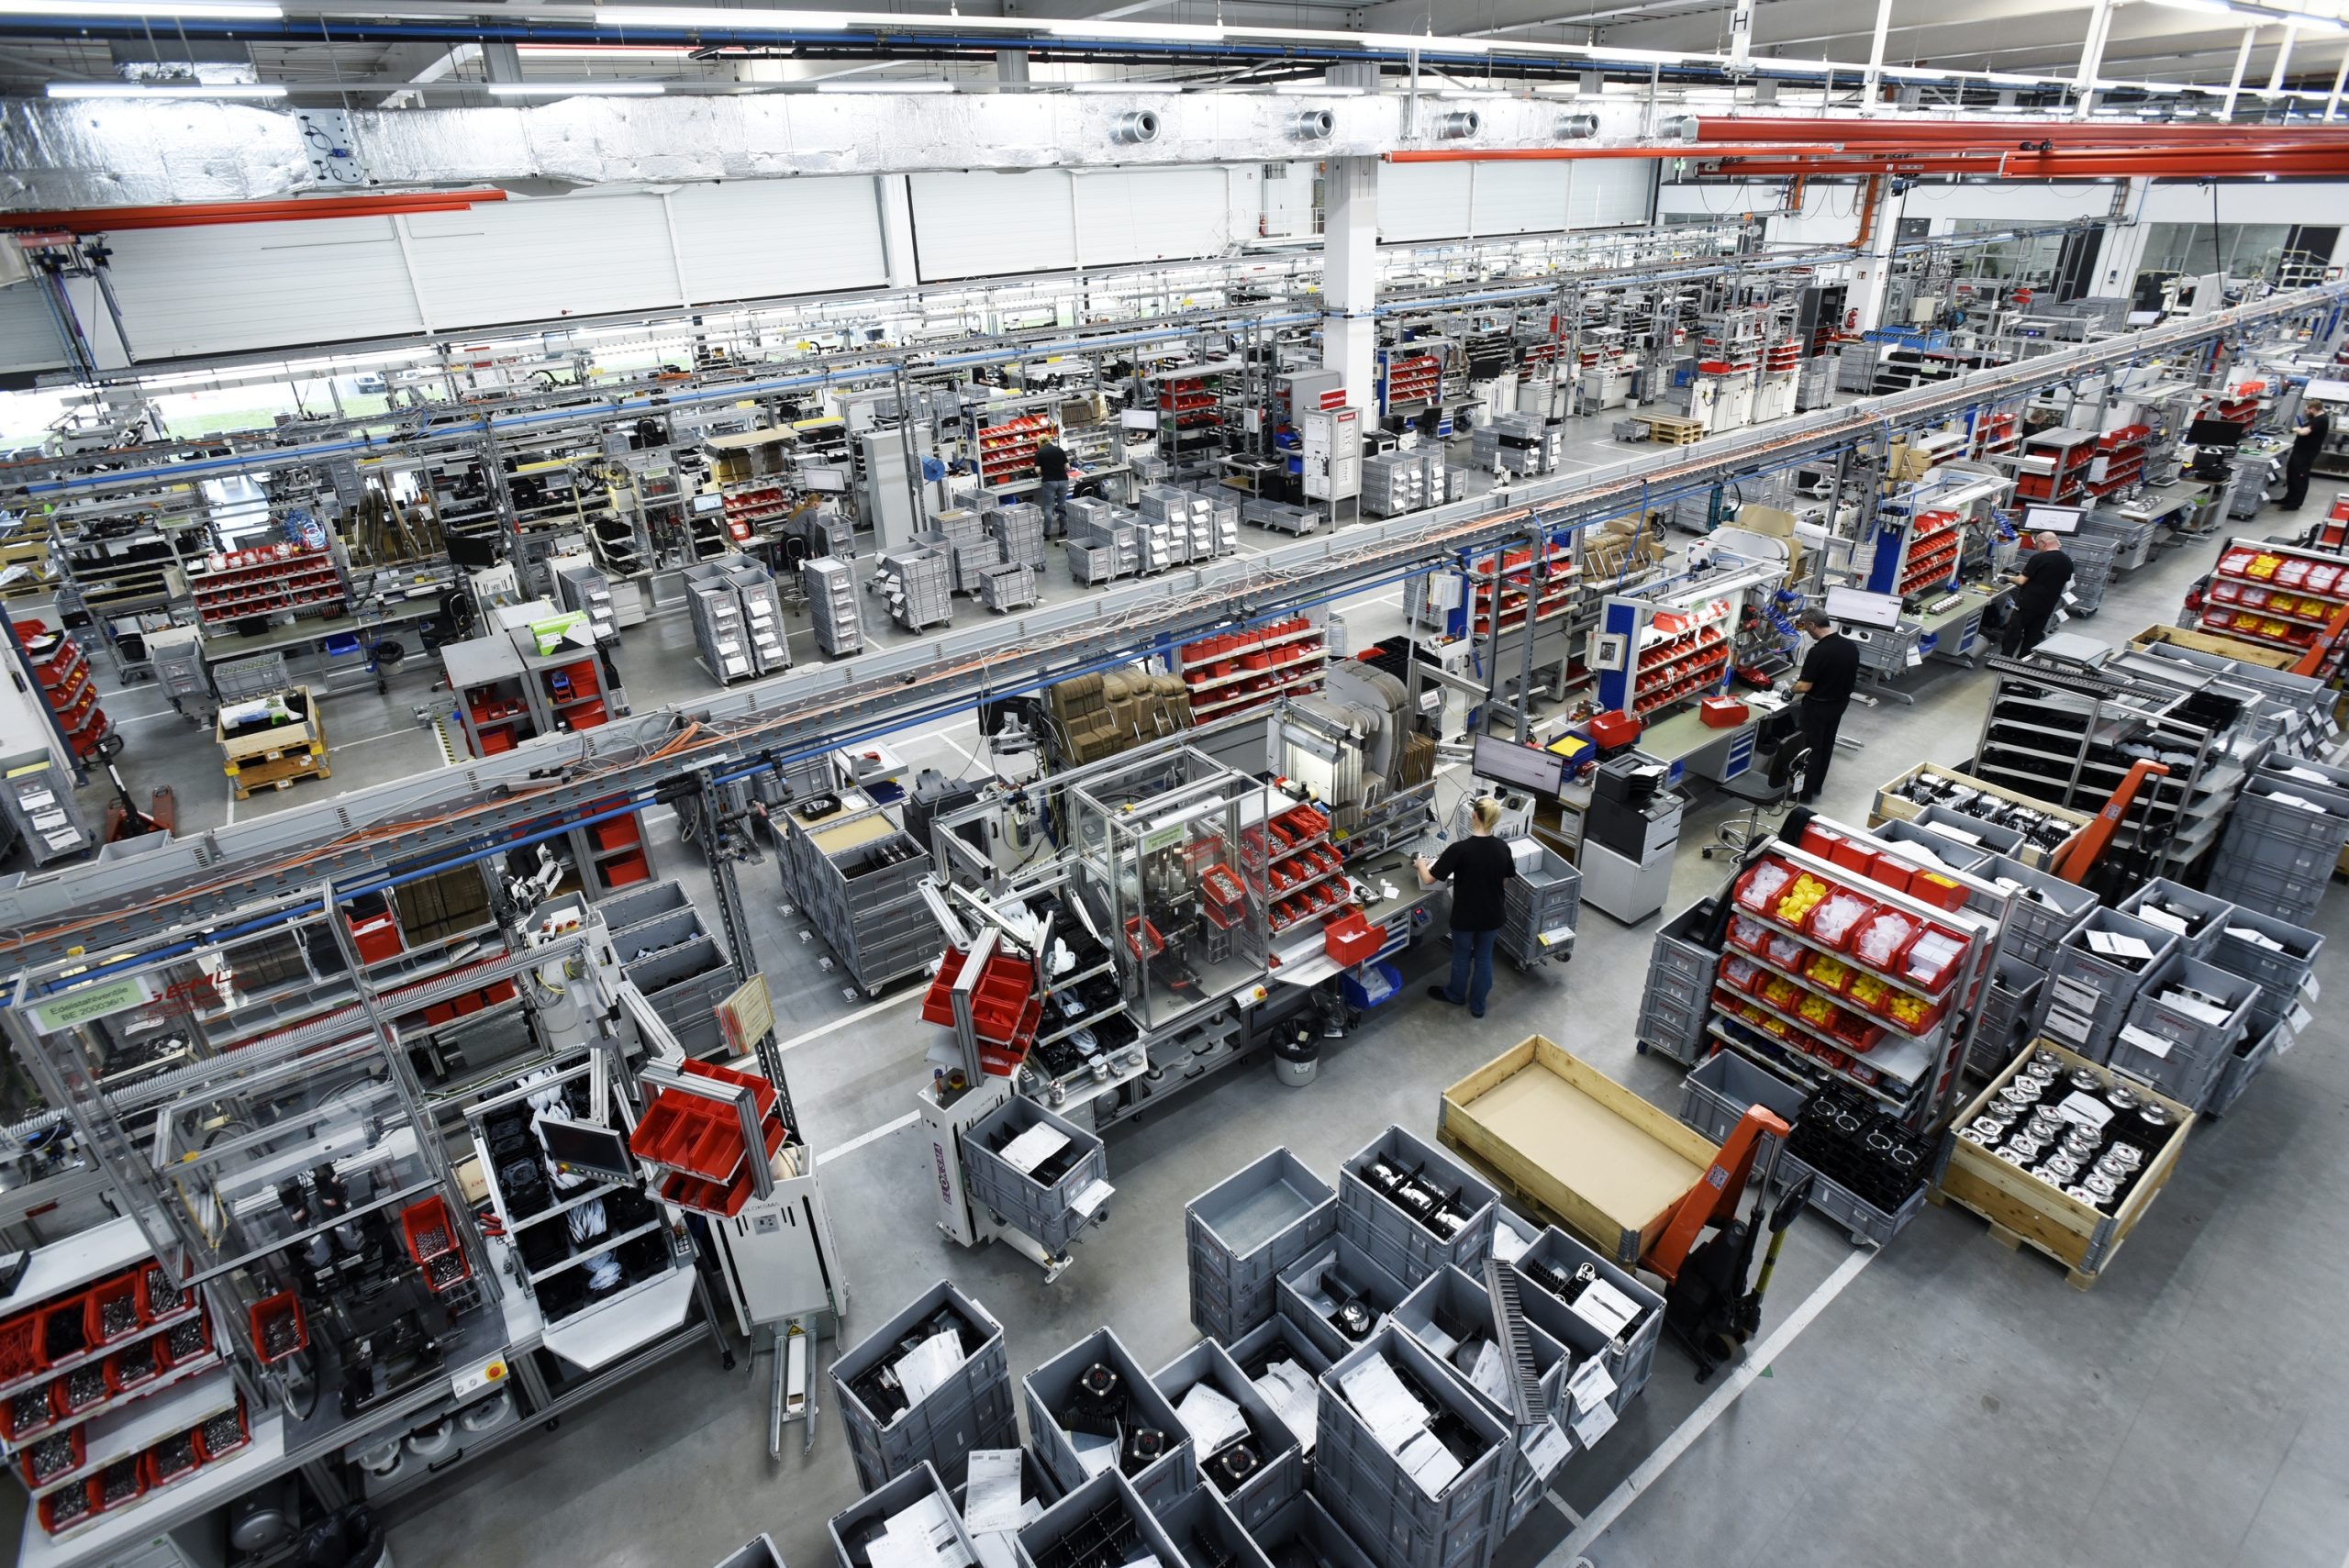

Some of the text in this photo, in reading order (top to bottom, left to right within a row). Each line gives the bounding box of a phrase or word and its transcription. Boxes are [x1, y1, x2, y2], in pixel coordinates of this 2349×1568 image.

[1733, 10, 1748, 31] H
[1867, 71, 1876, 83] J
[50, 986, 128, 1017] Edelstahlventile
[61, 1010, 77, 1021] BE
[934, 1141, 952, 1206] BLOKSMA
